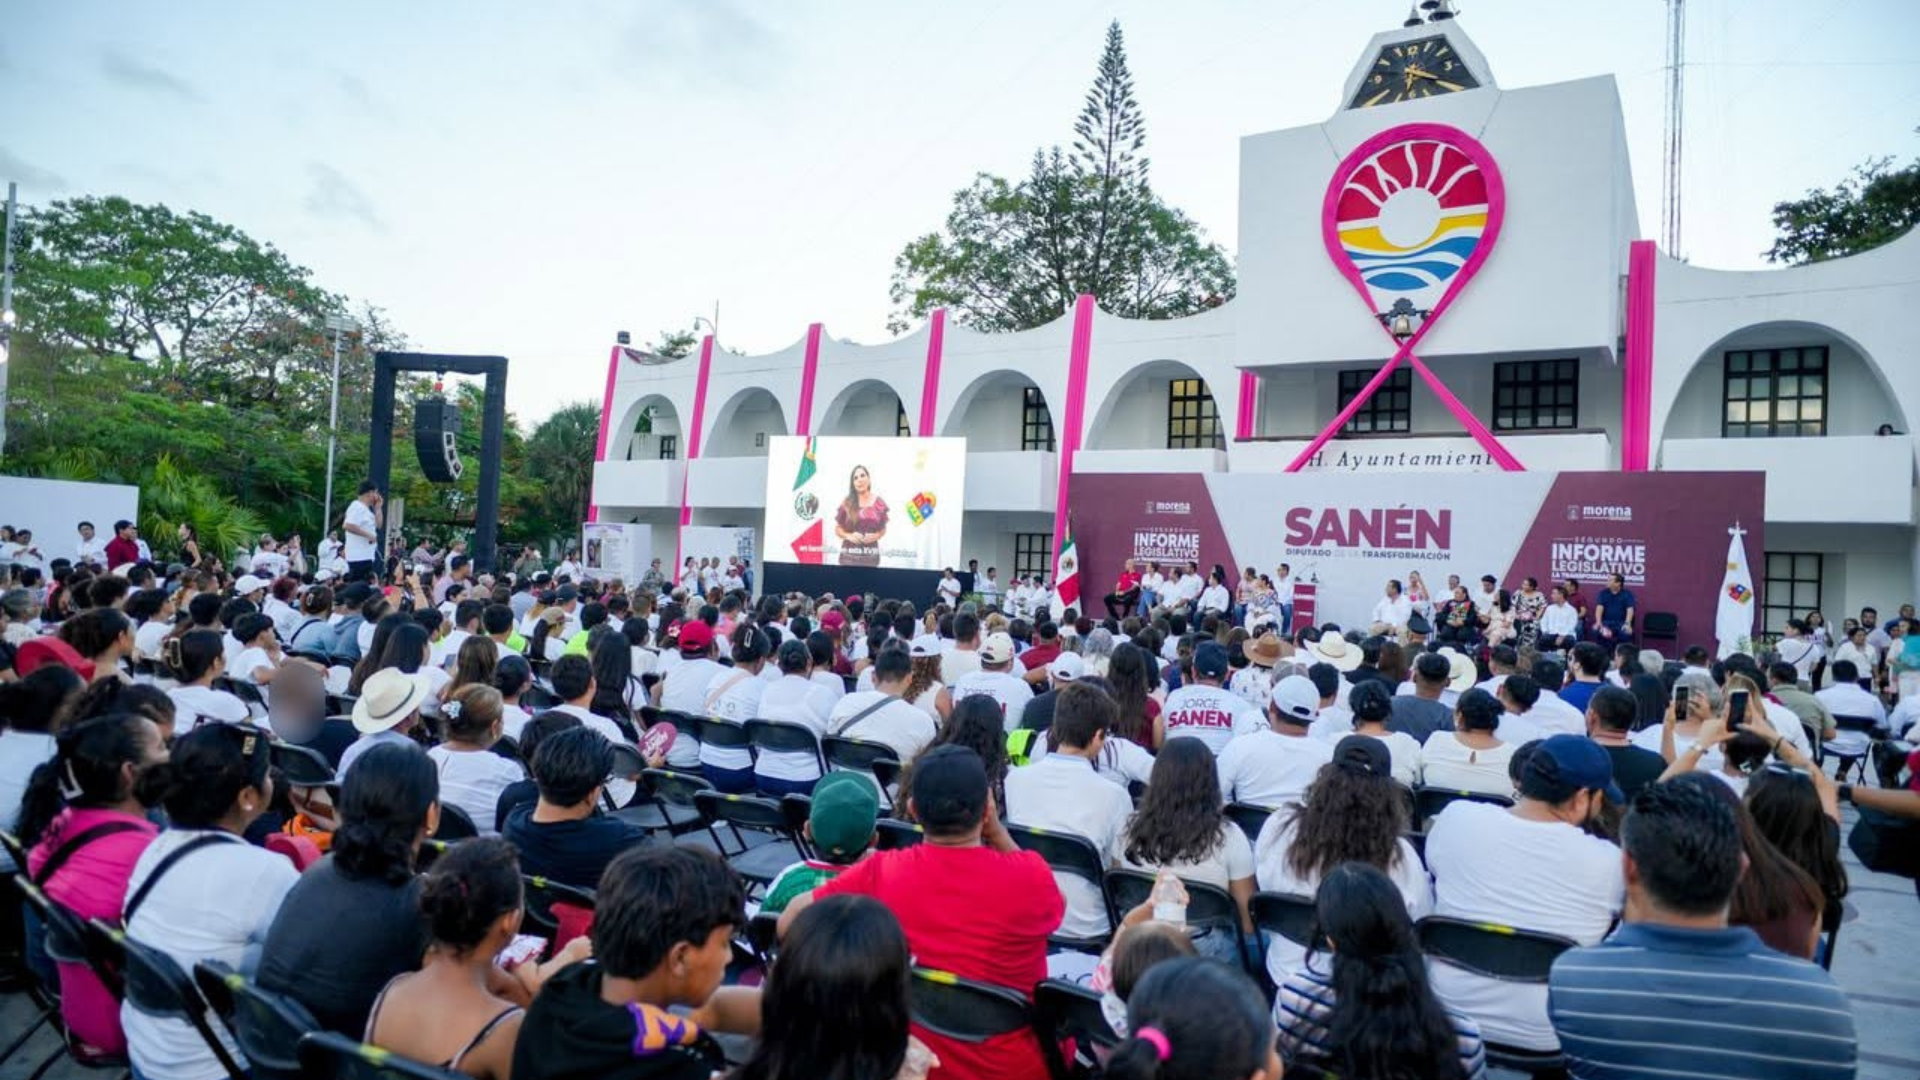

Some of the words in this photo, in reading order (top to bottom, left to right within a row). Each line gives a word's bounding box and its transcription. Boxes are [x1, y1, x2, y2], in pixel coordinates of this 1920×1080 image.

[1444, 61, 1453, 71] 3
[1337, 451, 1494, 471] Ayuntamient
[1156, 502, 1190, 511] morena
[1583, 506, 1631, 516] morena
[1284, 503, 1452, 550] SANÉN
[1134, 532, 1200, 548] INFORME
[1134, 546, 1199, 559] LEGISLATIVO
[1286, 548, 1331, 557] DIPUTADO
[1362, 550, 1451, 561] TRANSFORMACIÓN
[1552, 543, 1645, 563] INFORME
[1552, 560, 1645, 575] LEGISLATIVO
[1181, 698, 1220, 709] JORGE
